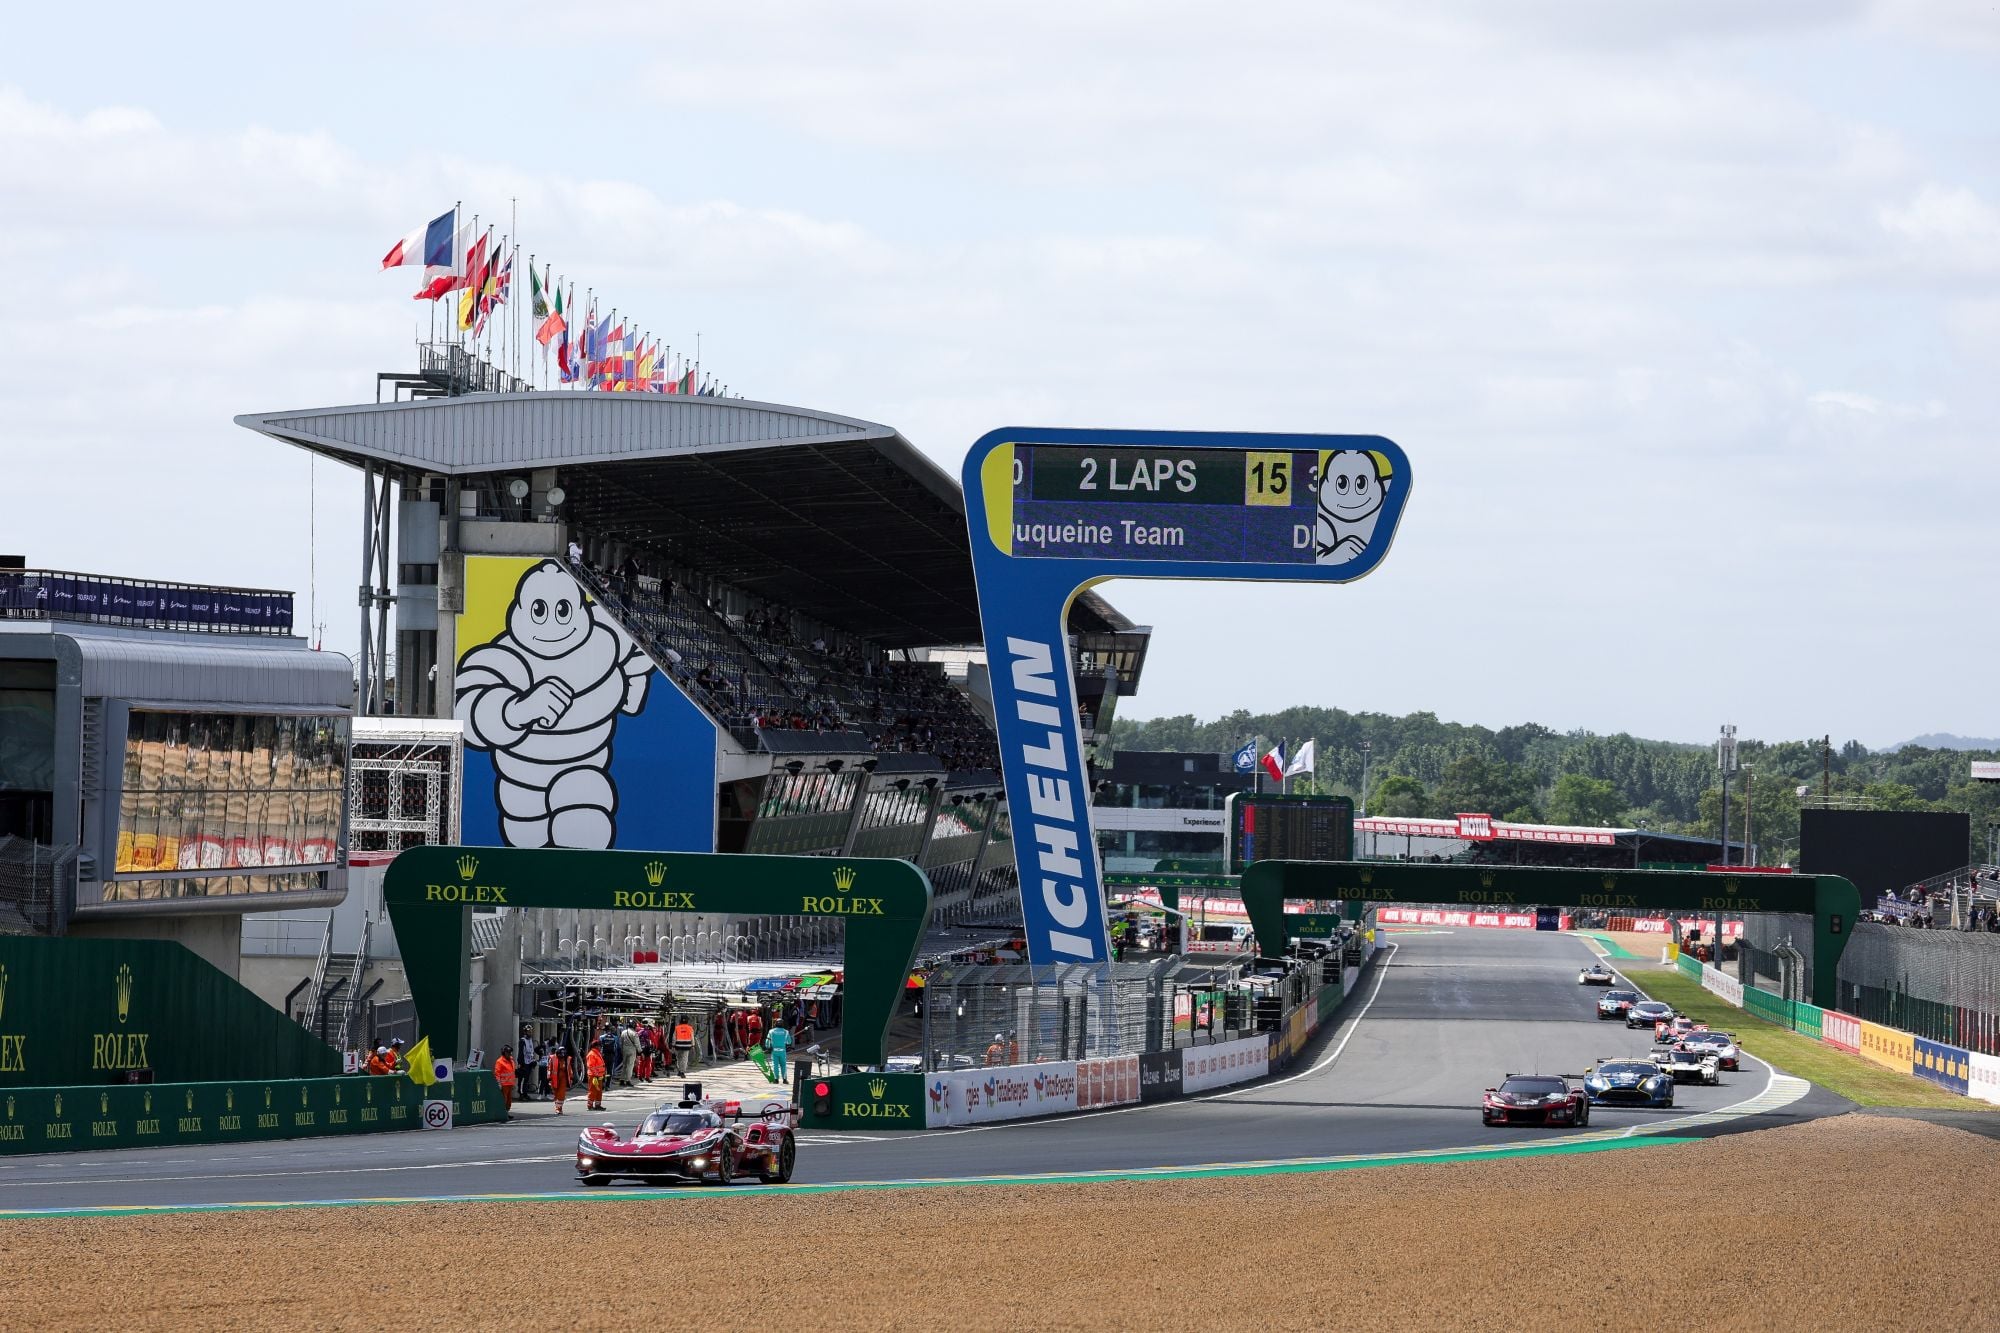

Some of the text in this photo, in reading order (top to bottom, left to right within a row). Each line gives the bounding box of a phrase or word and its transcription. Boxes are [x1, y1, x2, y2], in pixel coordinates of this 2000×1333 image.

[1079, 457, 1197, 493] 2 LAPS
[1252, 461, 1288, 494] 15
[1012, 519, 1185, 549] uqueine Team
[1460, 816, 1491, 837] MOTUL
[425, 884, 508, 904] ROLEX
[613, 890, 696, 910] ROLEX
[1337, 887, 1395, 900] ROLEX
[1459, 891, 1516, 903] ROLEX
[1580, 894, 1639, 906] ROLEX
[802, 896, 885, 915] ROLEX
[1702, 897, 1761, 910] ROLEX
[1474, 914, 1499, 926] MOTUL
[1504, 914, 1531, 927] MOTUL
[1633, 920, 1665, 932] MOTUL
[92, 1032, 150, 1070] ROLEX
[329, 1109, 348, 1124] ROLEX
[428, 1108, 446, 1122] 60
[842, 1102, 911, 1118] ROLEX
[178, 1117, 202, 1132] ROLEX
[219, 1115, 241, 1130] ROLEX
[258, 1113, 279, 1128] ROLEX
[295, 1111, 315, 1126] ROLEX
[46, 1123, 72, 1138] ROLEX
[92, 1121, 118, 1136] ROLEX
[136, 1119, 160, 1135] ROLEX
